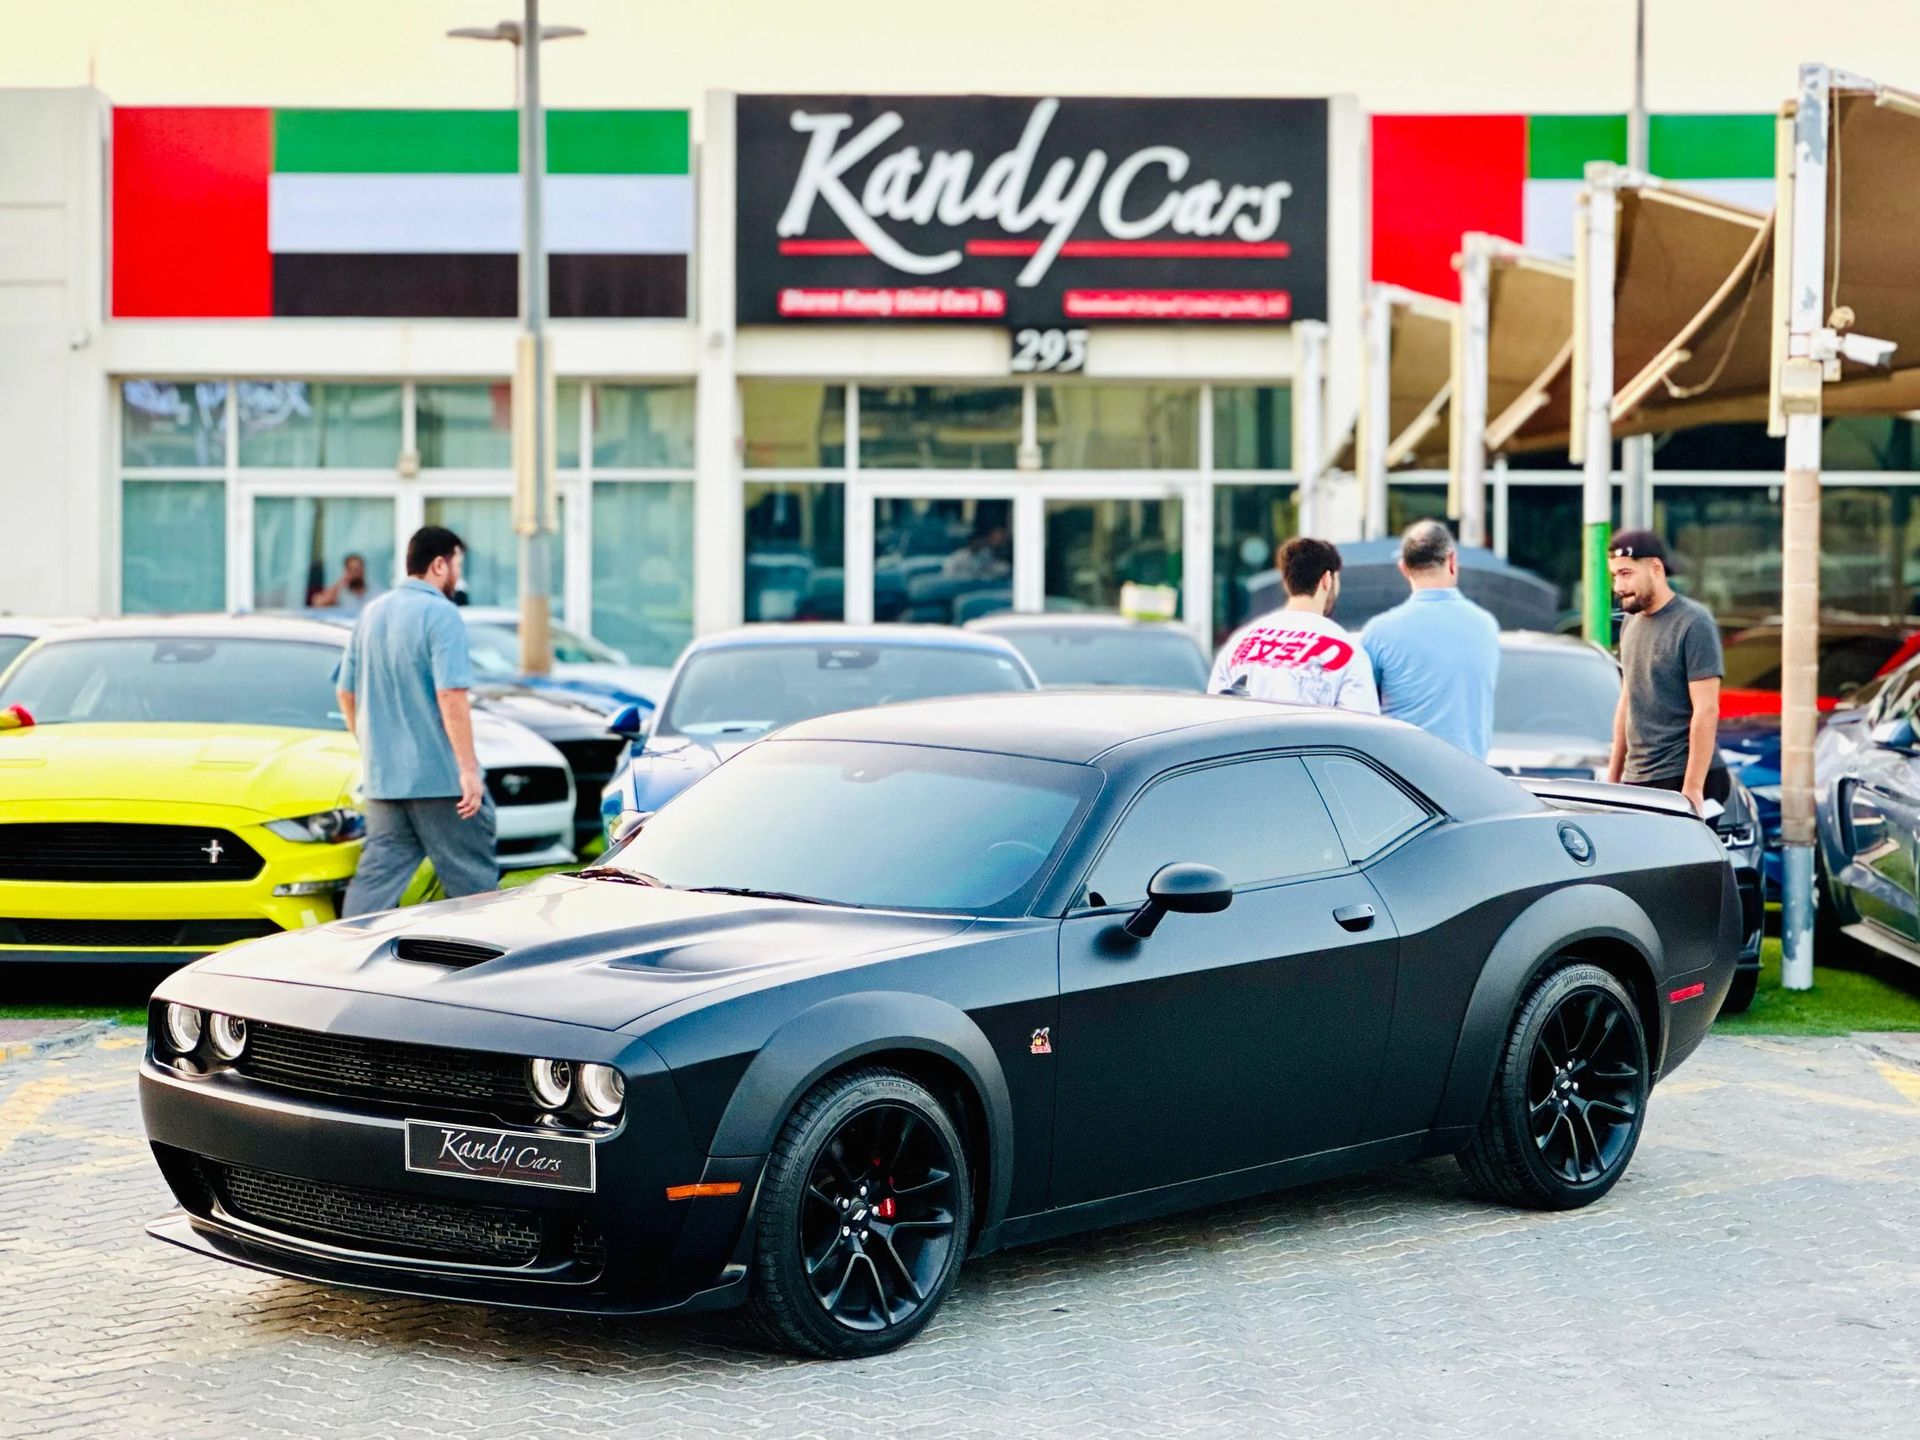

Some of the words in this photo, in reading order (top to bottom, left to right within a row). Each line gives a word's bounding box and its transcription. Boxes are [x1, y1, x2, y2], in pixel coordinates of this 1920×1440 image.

[777, 98, 1107, 286] Kandy
[1100, 145, 1292, 242] Cars
[1012, 328, 1088, 372] 295
[438, 1129, 515, 1177] Kandy
[515, 1147, 562, 1172] Cars
